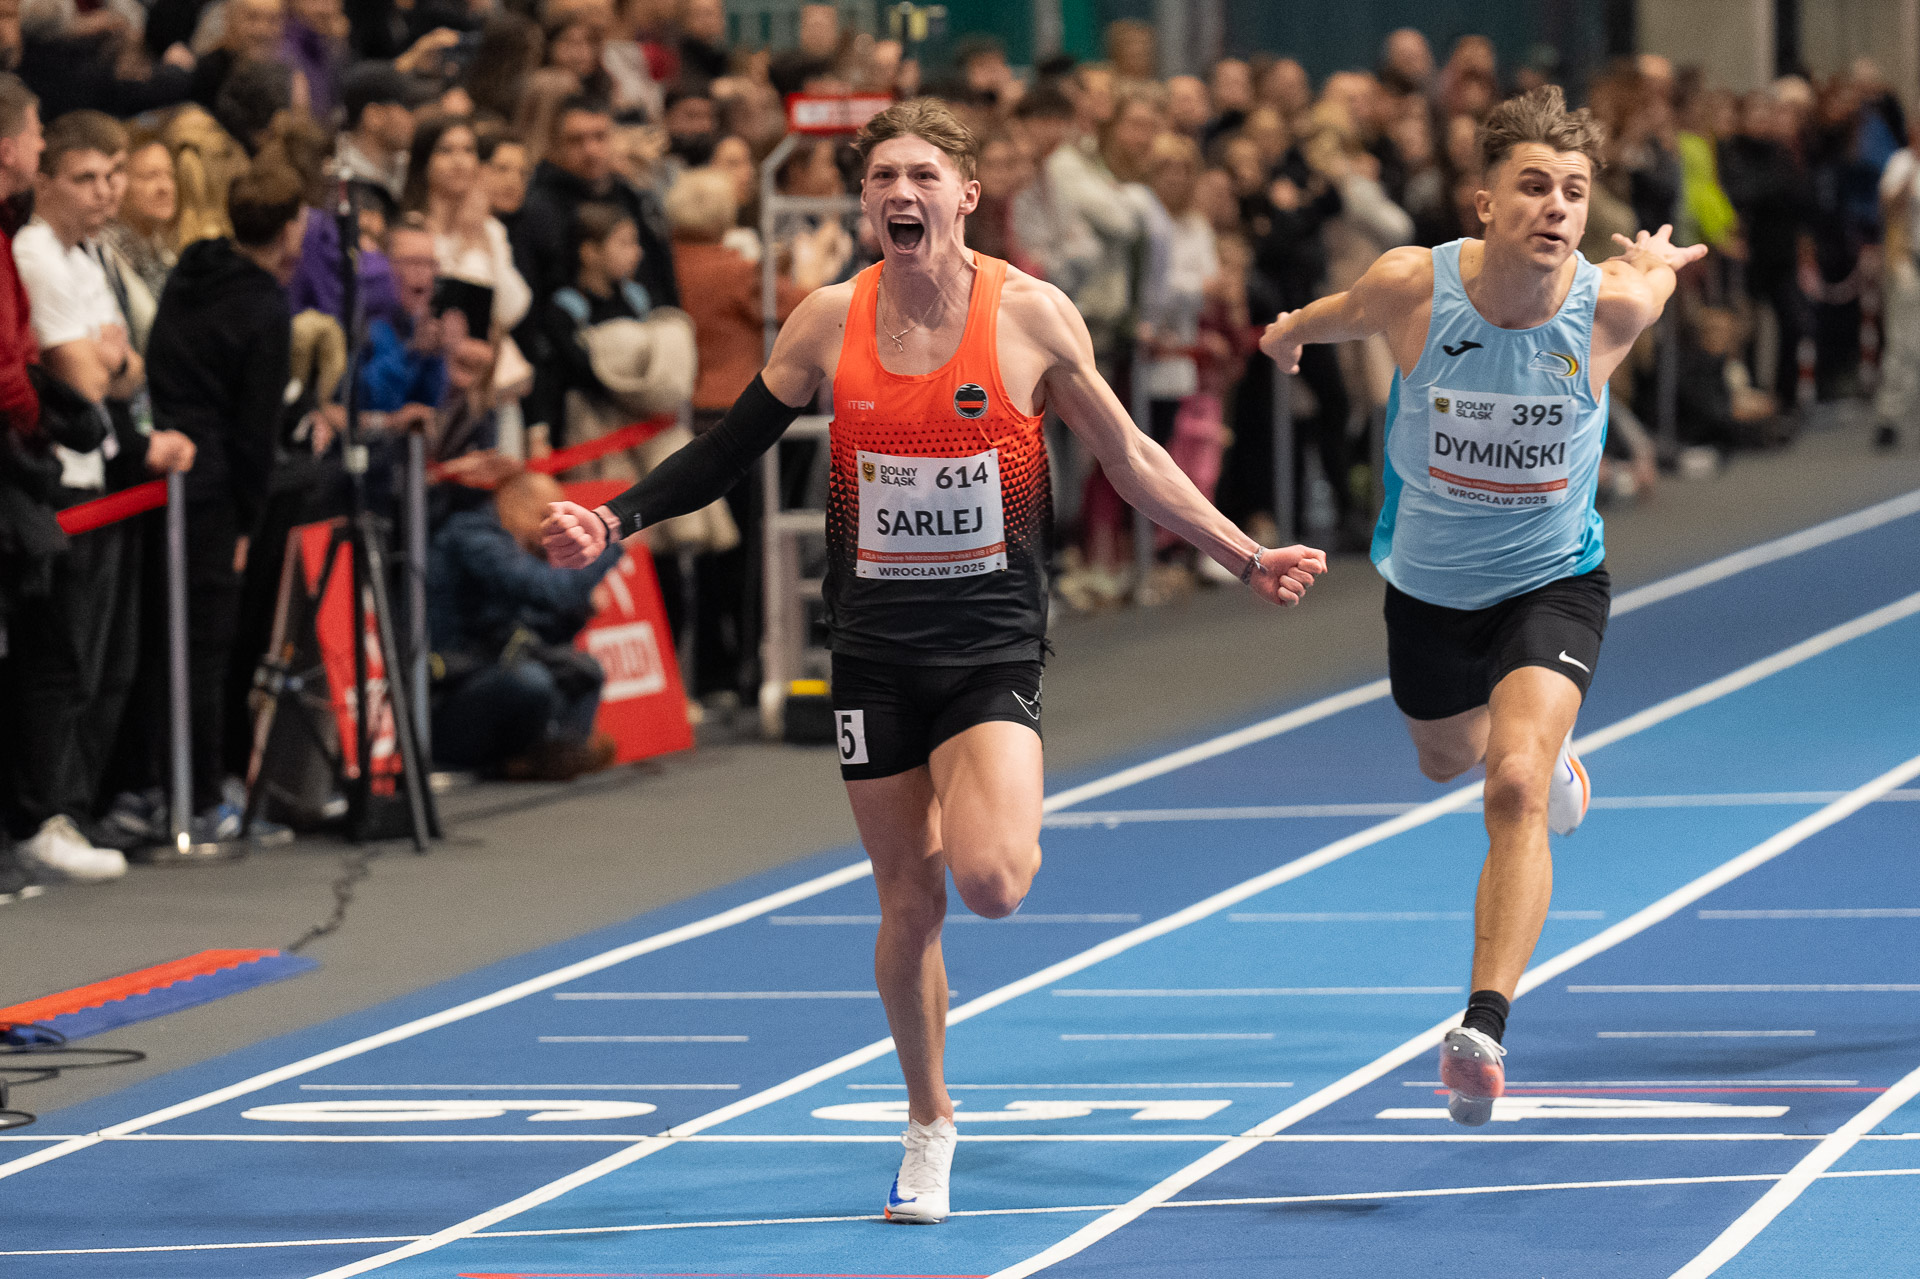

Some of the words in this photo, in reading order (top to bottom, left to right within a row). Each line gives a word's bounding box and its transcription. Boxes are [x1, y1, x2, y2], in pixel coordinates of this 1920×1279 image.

[1456, 400, 1496, 411] DOLNY
[1512, 404, 1563, 426] 395
[1435, 431, 1566, 470] DYMIŃSKI
[880, 465, 918, 477] DOLNY
[936, 461, 989, 490] 614
[1447, 486, 1515, 505] WROCŁAW
[1517, 495, 1548, 505] 2025
[877, 506, 983, 536] SARLEJ
[878, 566, 951, 577] WROCŁAW
[954, 562, 986, 575] 2025
[841, 715, 856, 760] 5
